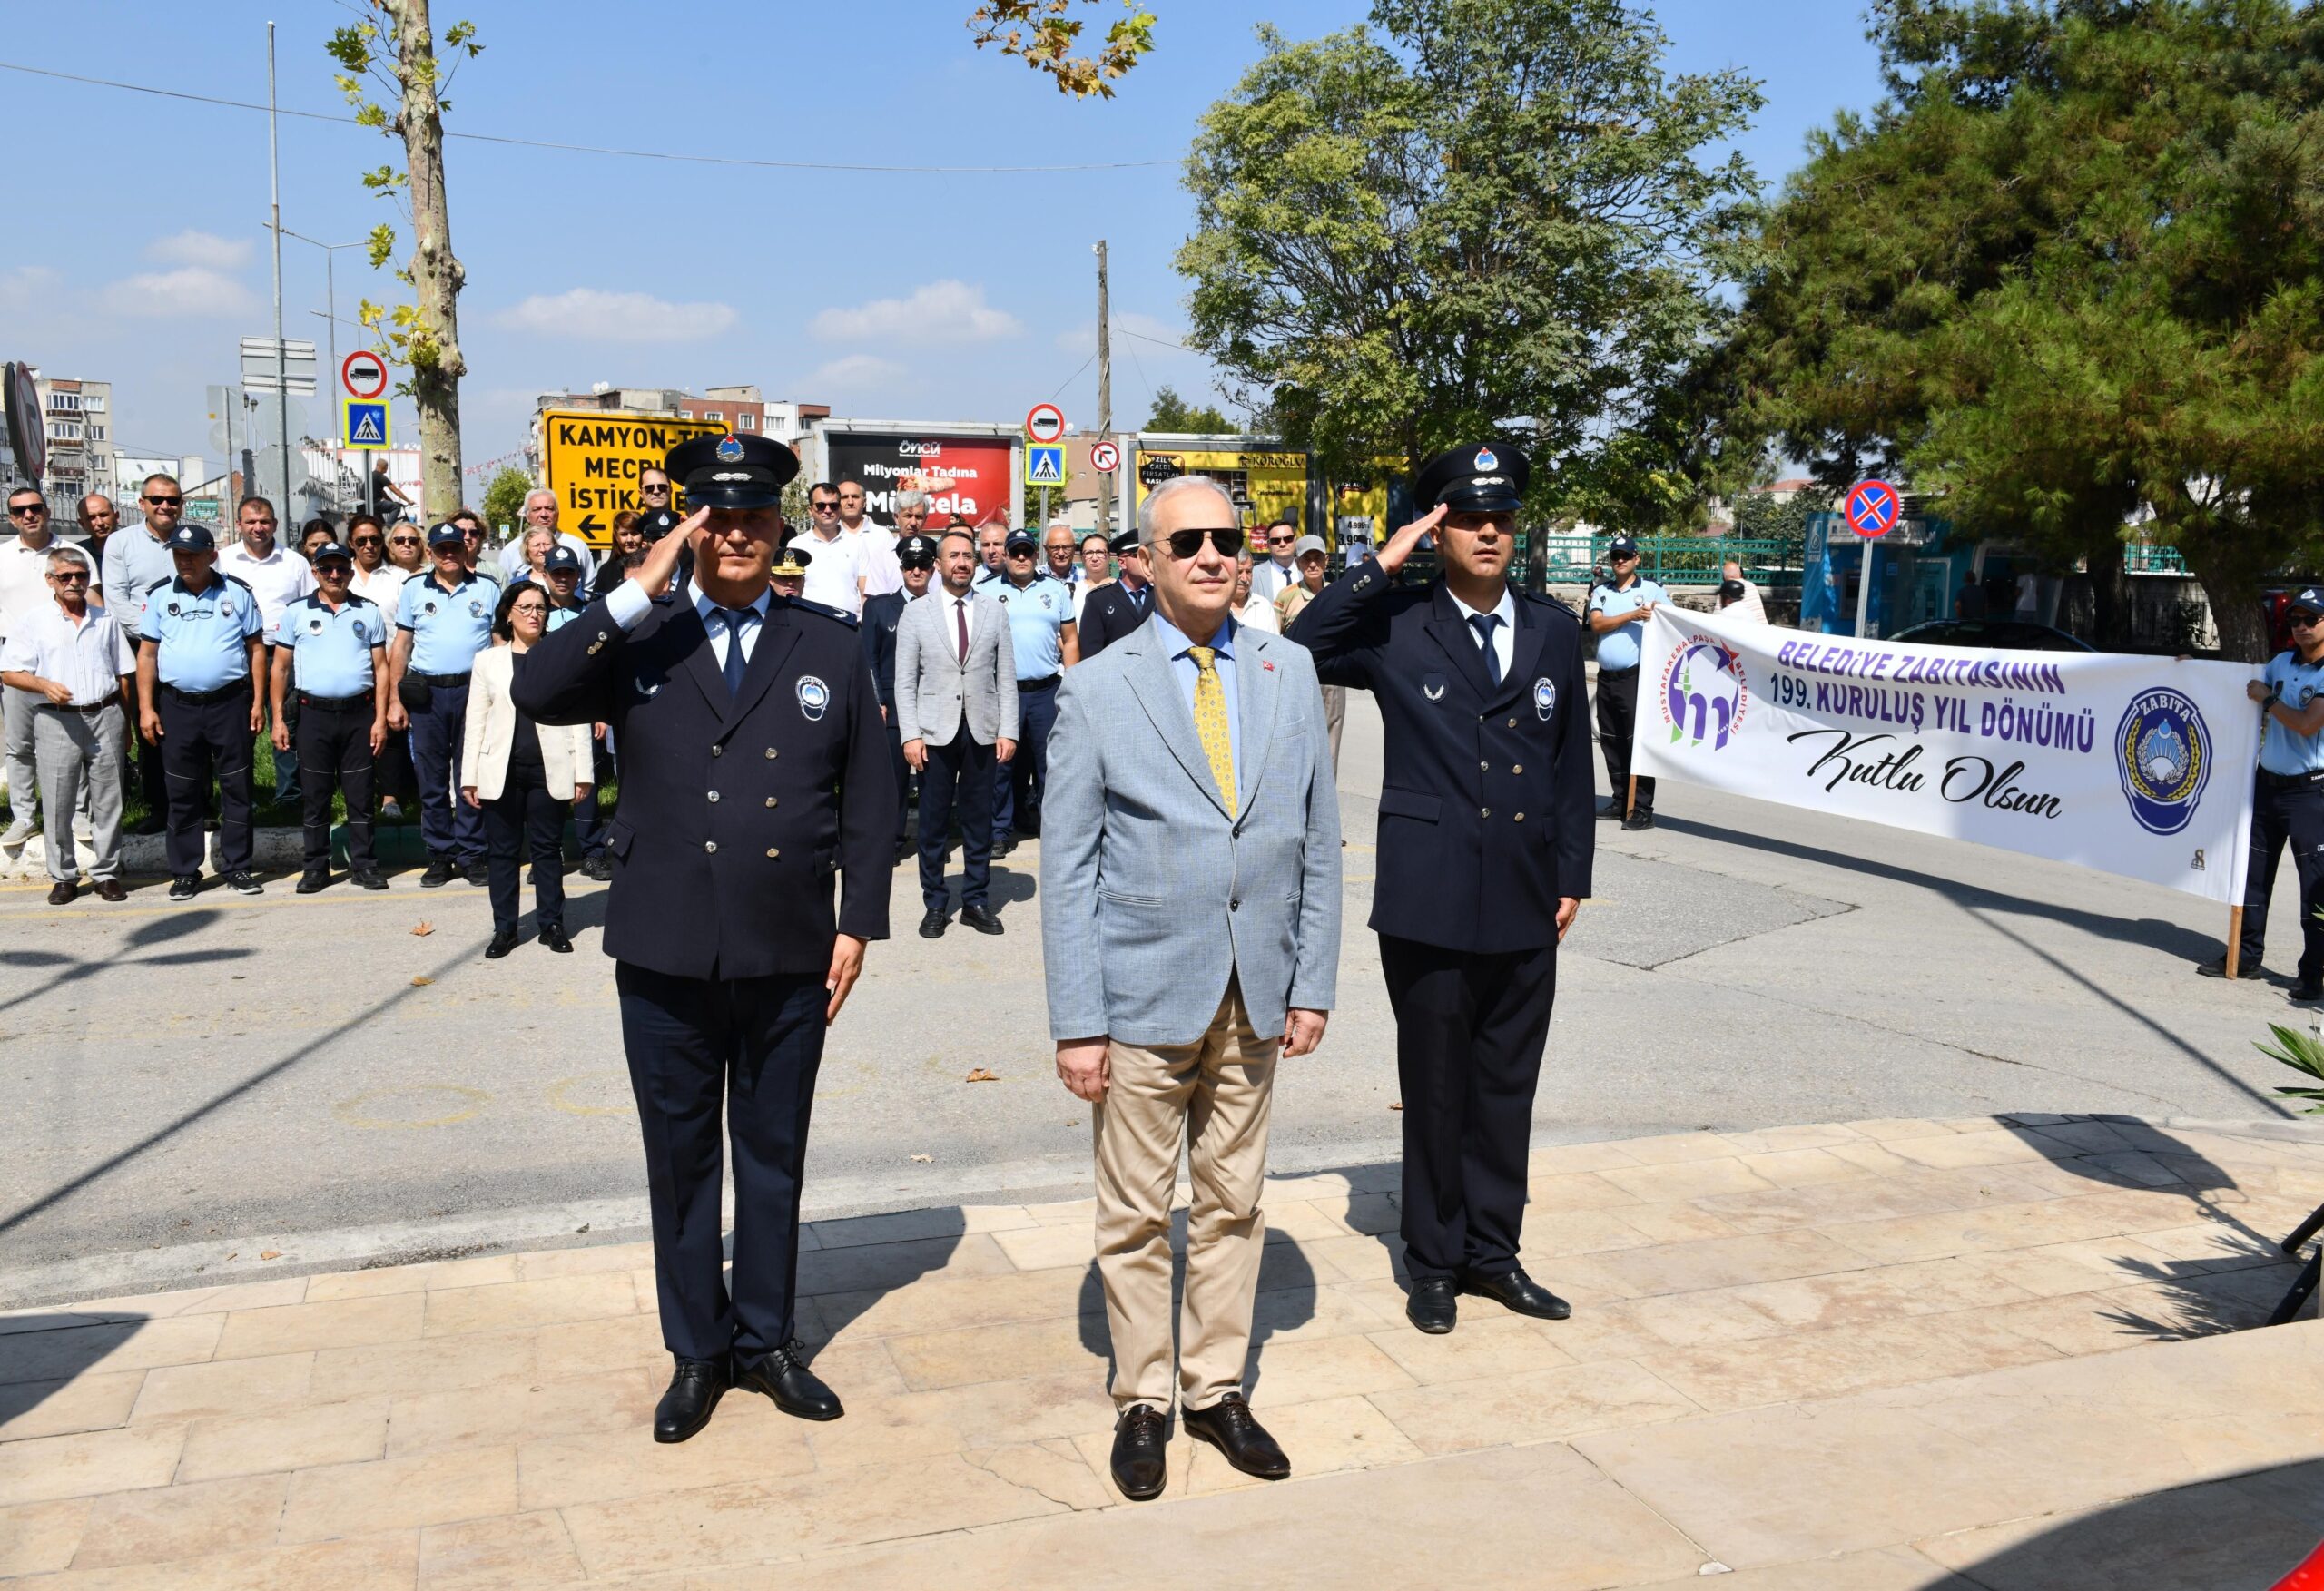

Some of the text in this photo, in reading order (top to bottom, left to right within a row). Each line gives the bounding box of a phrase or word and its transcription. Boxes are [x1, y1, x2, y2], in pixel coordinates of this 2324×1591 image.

[863, 464, 978, 479] Milyonlar Tadına
[1892, 656, 2066, 694] ZABITASININ
[1770, 673, 2095, 753] 199. KURULUŞ YIL DÖNÜMÜ
[2140, 694, 2191, 723] ZABITA
[1787, 729, 2062, 819] Kutlu Olsun
